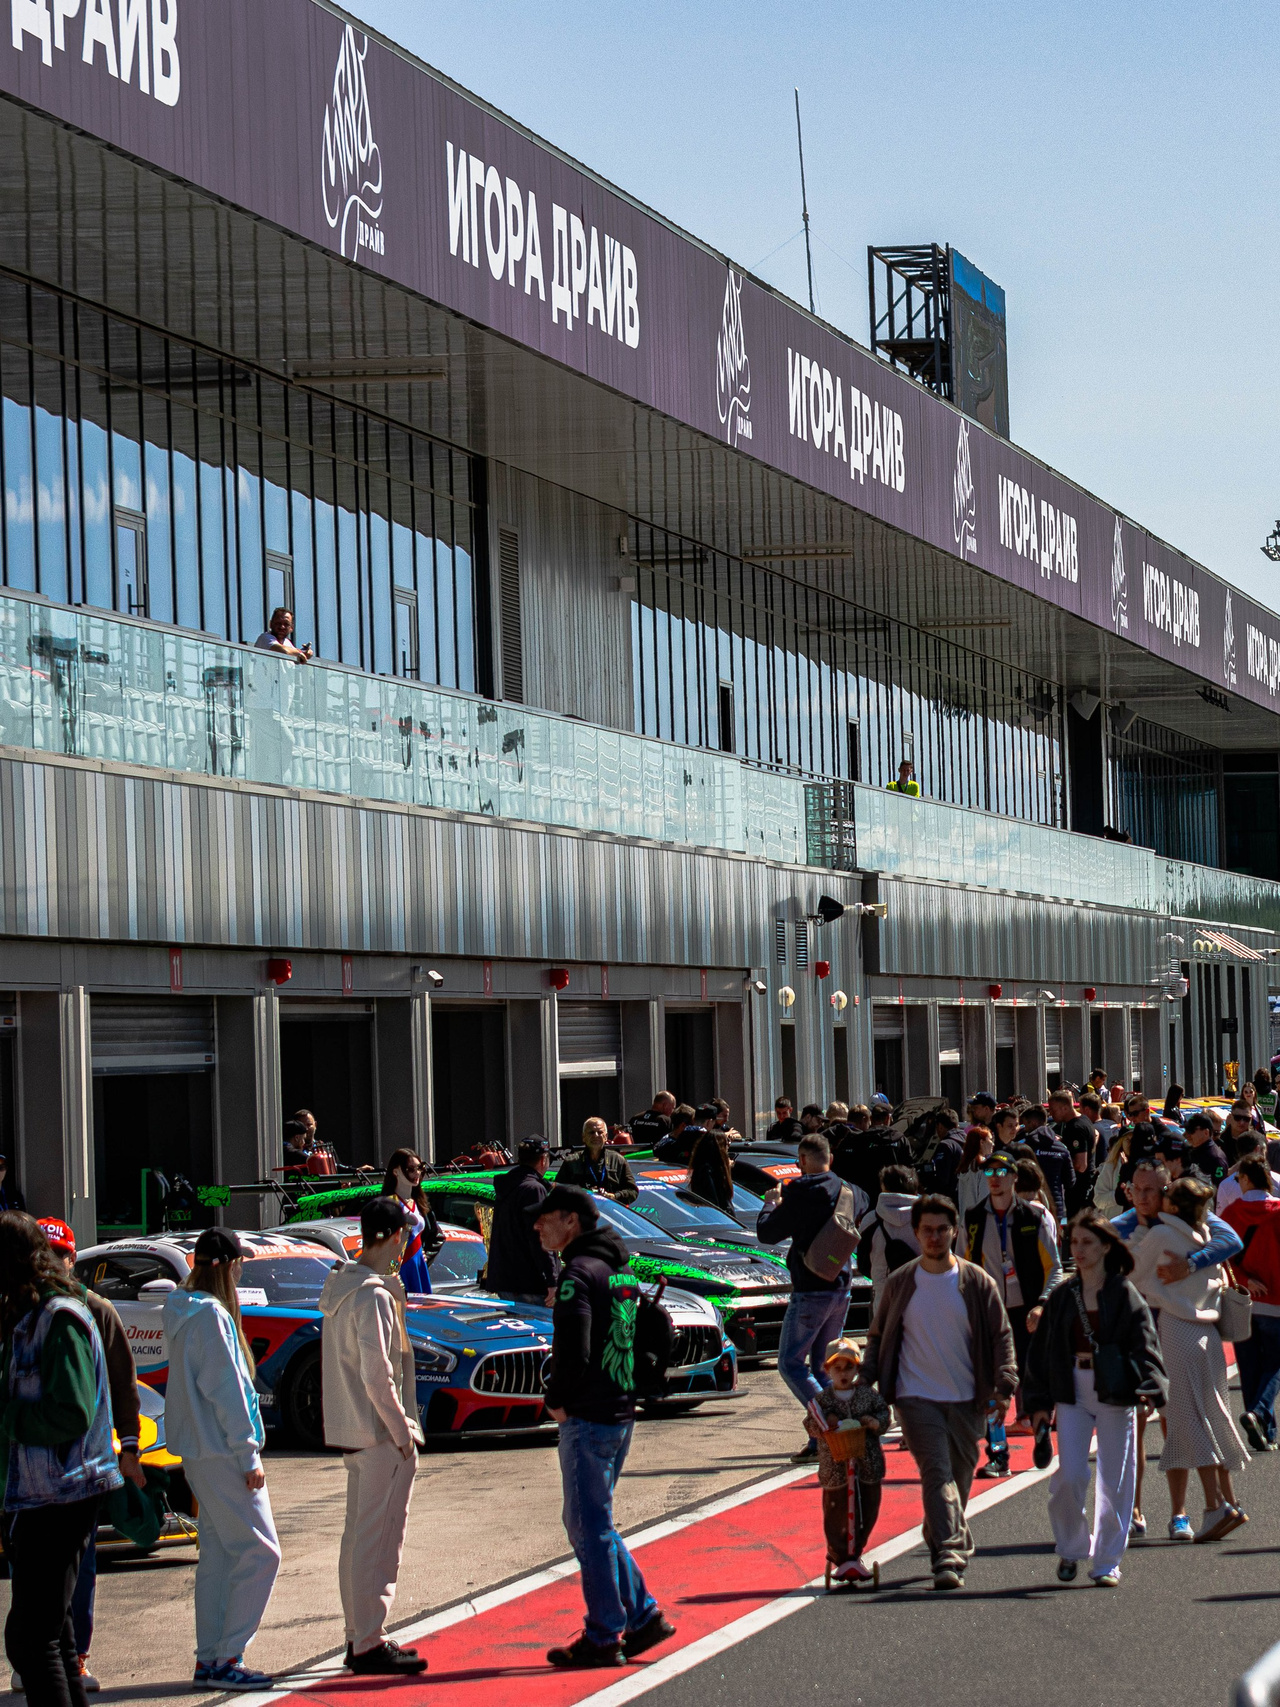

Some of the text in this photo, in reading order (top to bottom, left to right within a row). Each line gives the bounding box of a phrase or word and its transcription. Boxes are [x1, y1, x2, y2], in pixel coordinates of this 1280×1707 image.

[359, 221, 385, 256] ДРАЙВ
[446, 140, 640, 349] ИГОРА ДРАЙВ
[787, 347, 905, 494] ИГОРА ДРАЙВ
[998, 473, 1039, 564] ИГОРА
[1040, 499, 1079, 584] ДРАЙВ
[1143, 561, 1172, 634] ИГОРА
[1172, 579, 1200, 648] ДРАЙВ
[1246, 623, 1269, 686] ИГОРА
[172, 955, 181, 986] 11
[343, 961, 352, 989] 10
[1215, 1166, 1224, 1178] 5
[560, 1280, 576, 1301] 5
[127, 1325, 164, 1341] DRIVE
[132, 1345, 163, 1355] RACING
